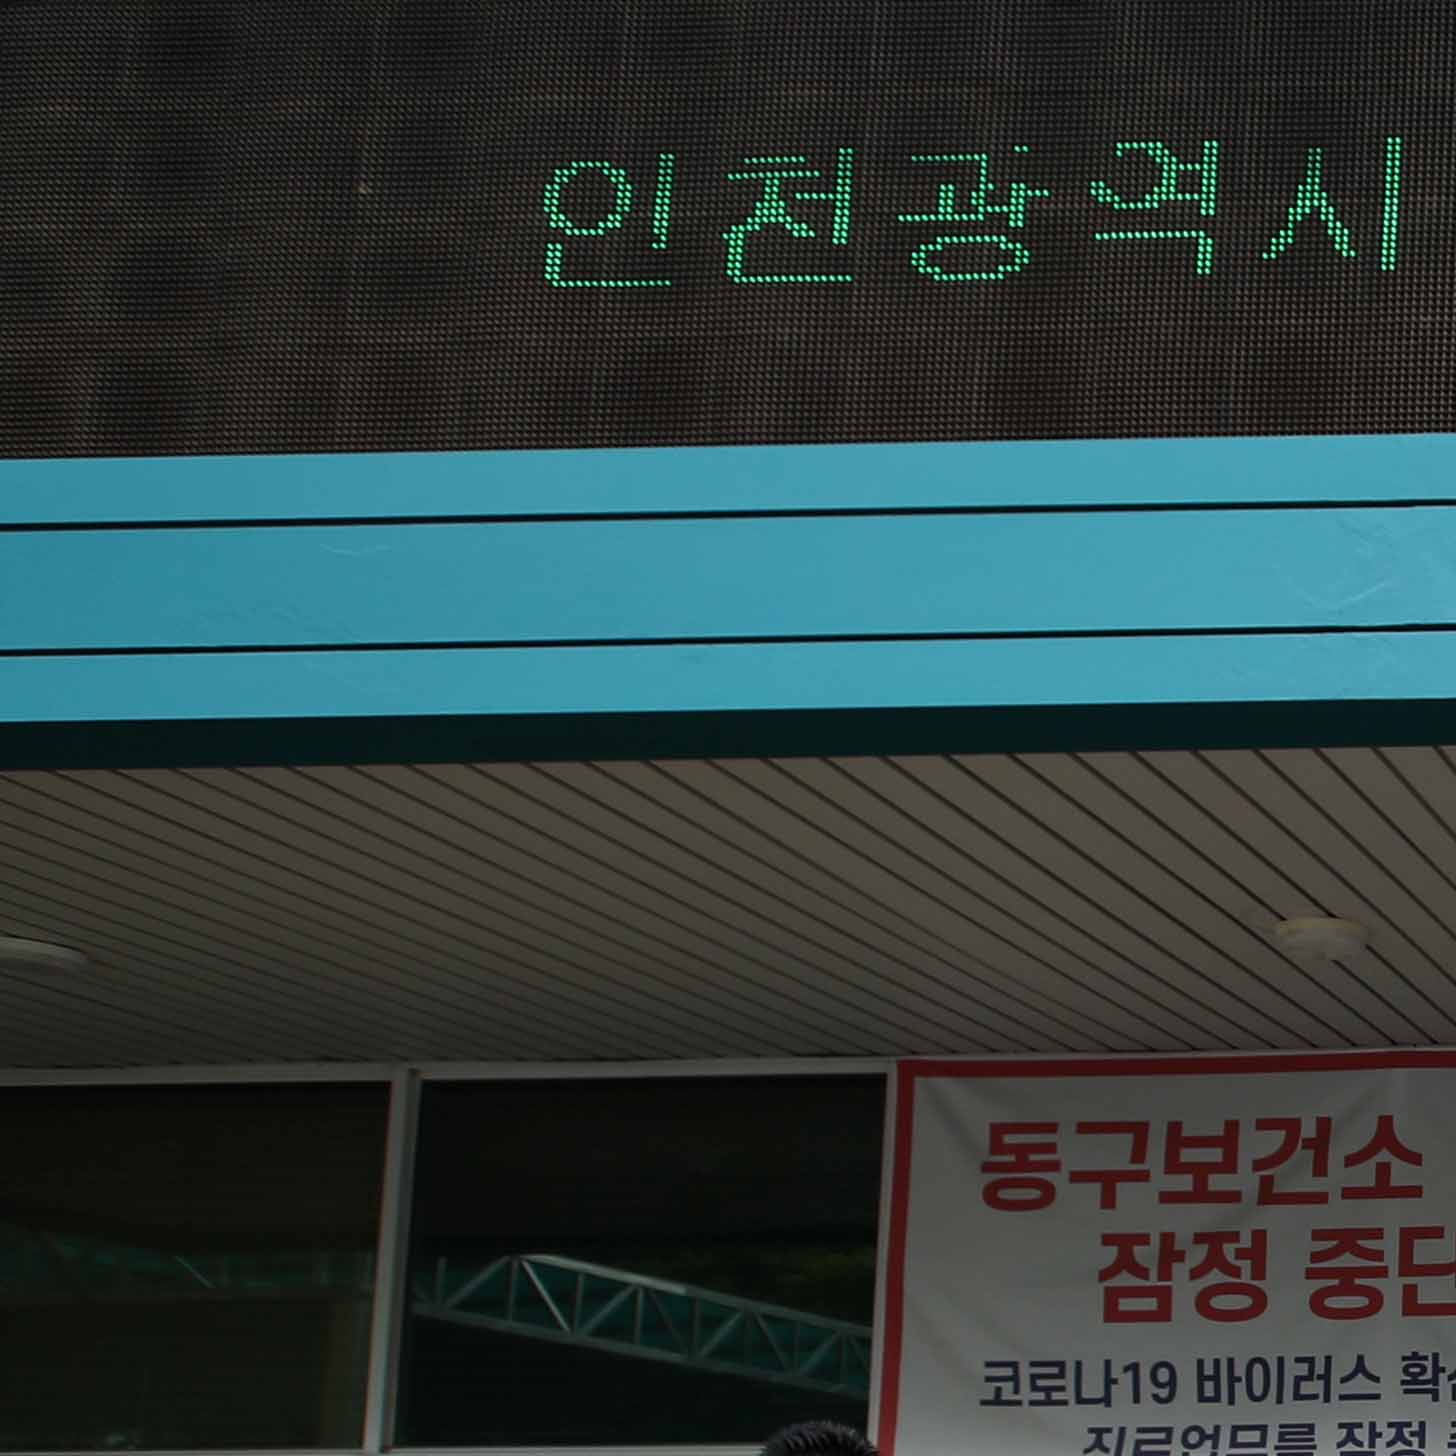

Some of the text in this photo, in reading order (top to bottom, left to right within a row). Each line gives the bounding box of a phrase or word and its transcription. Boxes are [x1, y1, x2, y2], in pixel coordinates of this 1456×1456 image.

[540, 136, 1404, 288] 인천광역시
[980, 1112, 1424, 1212] 동구보건소
[1096, 1228, 1268, 1325] 잠정
[979, 1355, 1178, 1410] 코로나19
[1197, 1353, 1383, 1404] 바이러스
